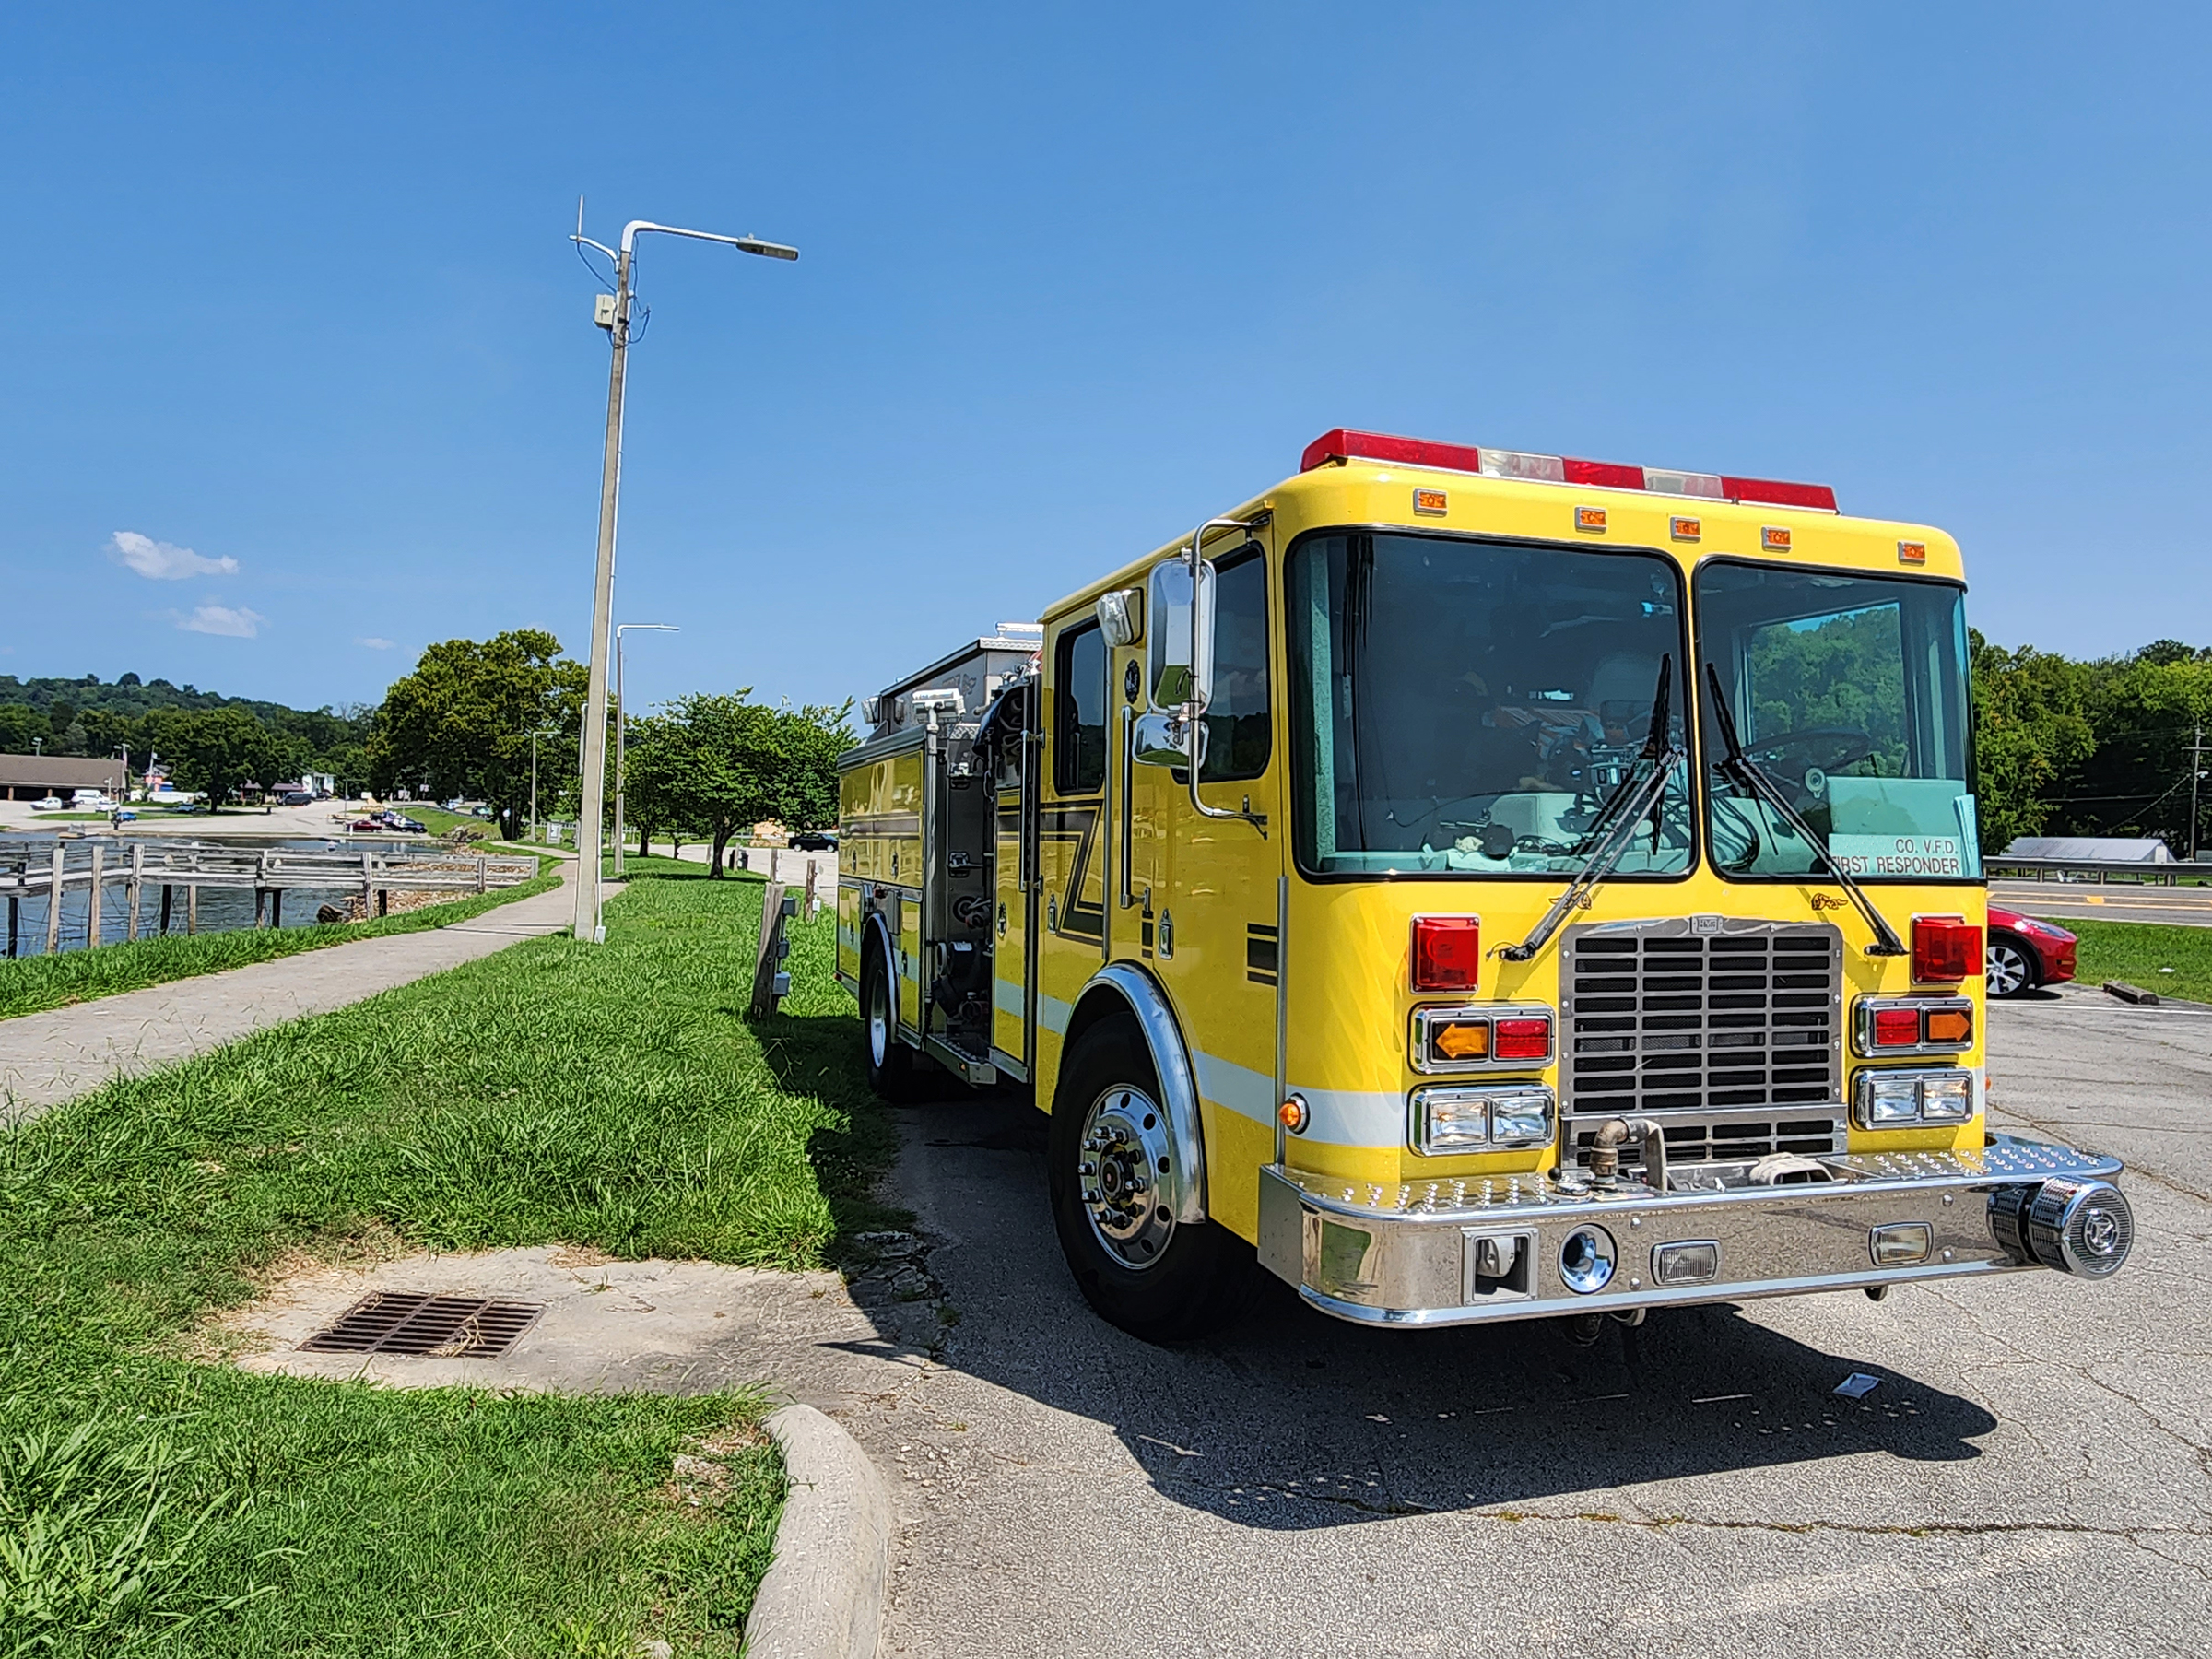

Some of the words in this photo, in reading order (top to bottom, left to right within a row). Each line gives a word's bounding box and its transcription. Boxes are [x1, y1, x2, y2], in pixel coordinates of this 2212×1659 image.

[1896, 839, 1918, 853] CO.
[1924, 840, 1958, 853] V.F.D.
[1877, 856, 1959, 874] RESPONDER
